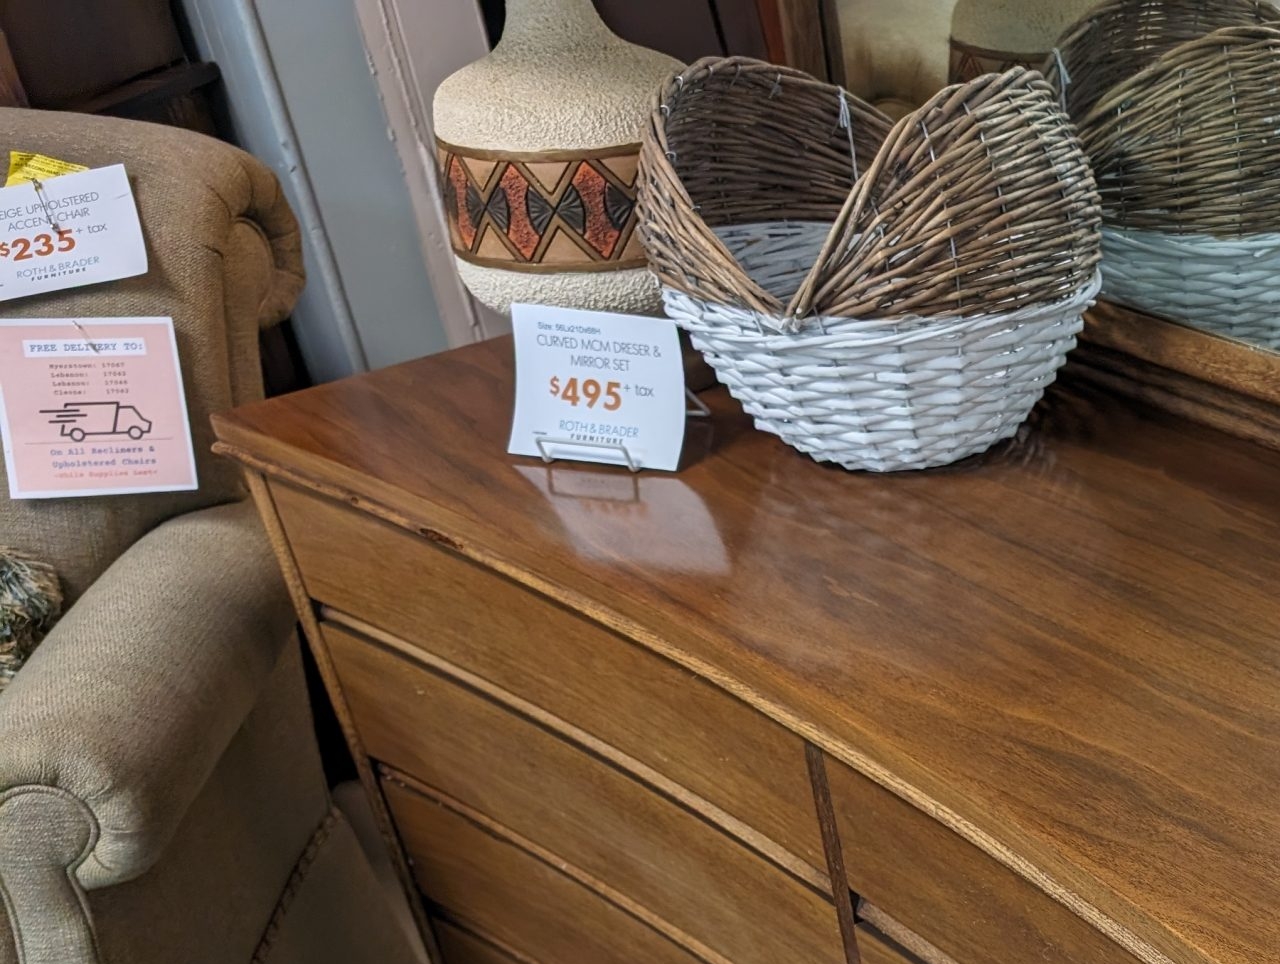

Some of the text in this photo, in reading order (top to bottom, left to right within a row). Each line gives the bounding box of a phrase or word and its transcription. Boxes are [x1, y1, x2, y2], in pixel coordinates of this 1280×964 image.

[0, 192, 99, 220] EIGE UPHOLSTERED
[8, 207, 90, 232] ACCENT CHAIR
[0, 229, 75, 262] $235
[88, 224, 108, 234] tax
[16, 256, 100, 279] ROTH & BRADER
[31, 267, 87, 282] FURNITURE
[29, 344, 57, 353] FREE
[123, 342, 144, 351] TO:
[536, 334, 661, 357] CURVED MCM DRESER &
[570, 354, 631, 371] MIRROR SET
[549, 375, 622, 411] $495
[635, 385, 654, 397] tax
[559, 420, 639, 437] ROTH & BRADER
[570, 433, 624, 444] FURNITURE
[50, 448, 63, 456] On
[68, 447, 85, 455] All
[92, 446, 143, 455] Recliners
[52, 458, 157, 469] Upholstered Chairs
